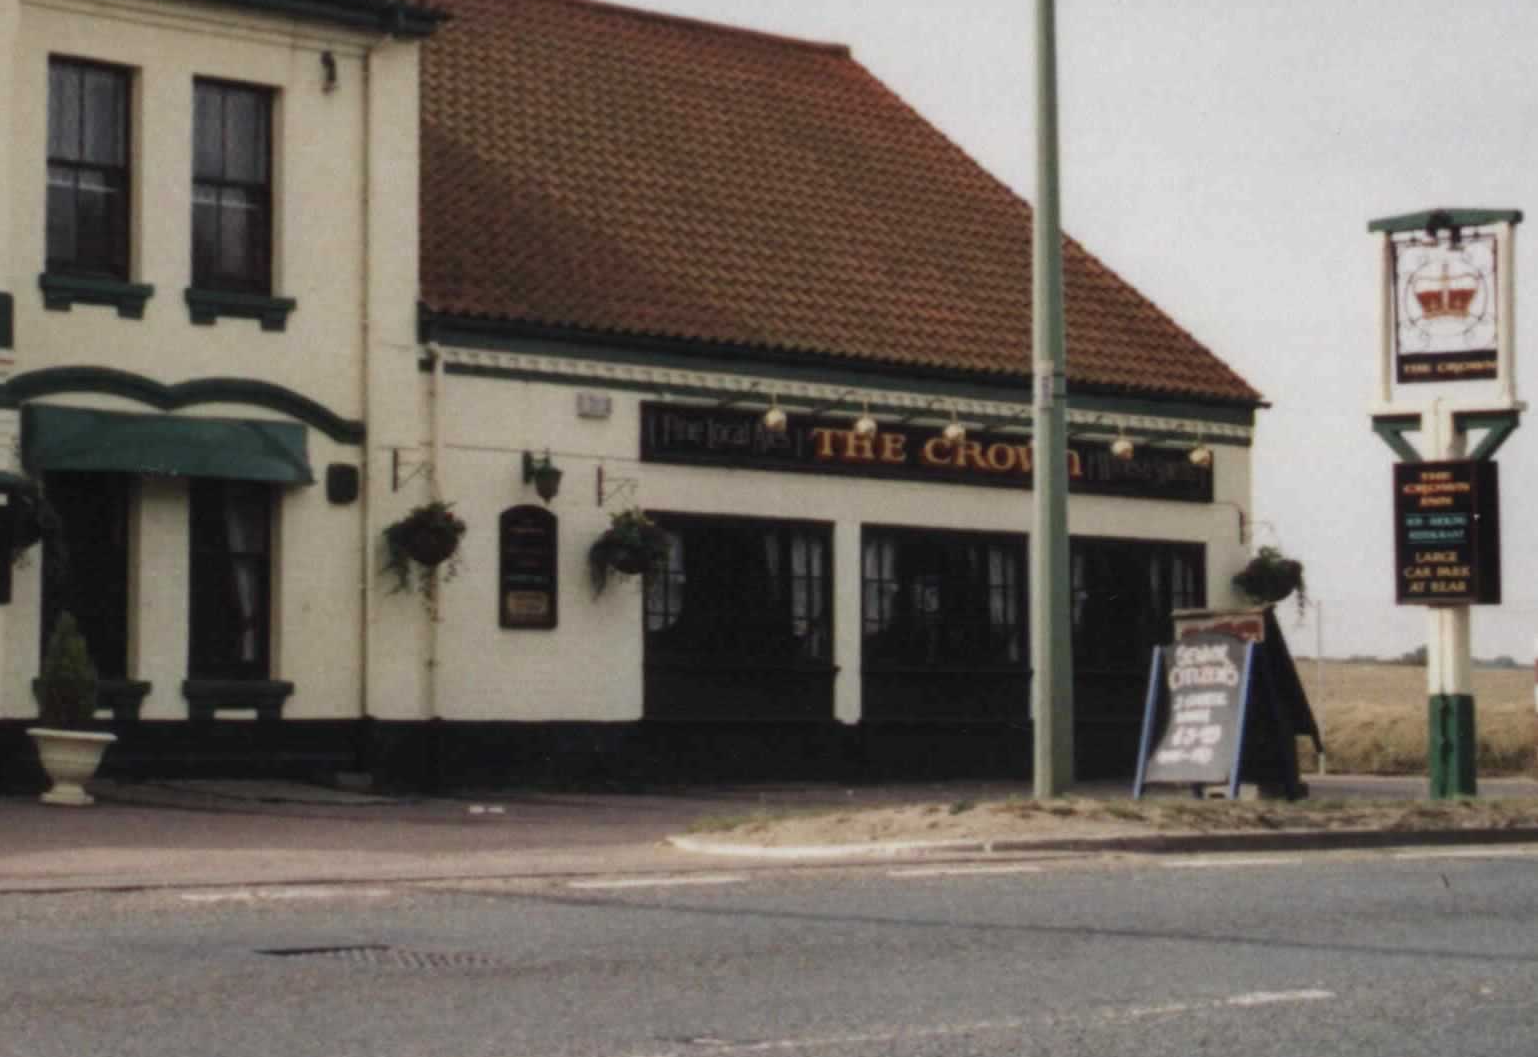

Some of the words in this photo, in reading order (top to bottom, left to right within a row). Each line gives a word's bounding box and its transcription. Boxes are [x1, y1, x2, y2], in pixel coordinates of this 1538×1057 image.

[1403, 363, 1431, 374] THE
[813, 428, 907, 462] THE
[1415, 550, 1458, 562] LARGE
[1403, 565, 1432, 577] CAR
[1436, 565, 1470, 577] PARK
[1409, 581, 1425, 592] AT
[1430, 581, 1466, 592] REAR
